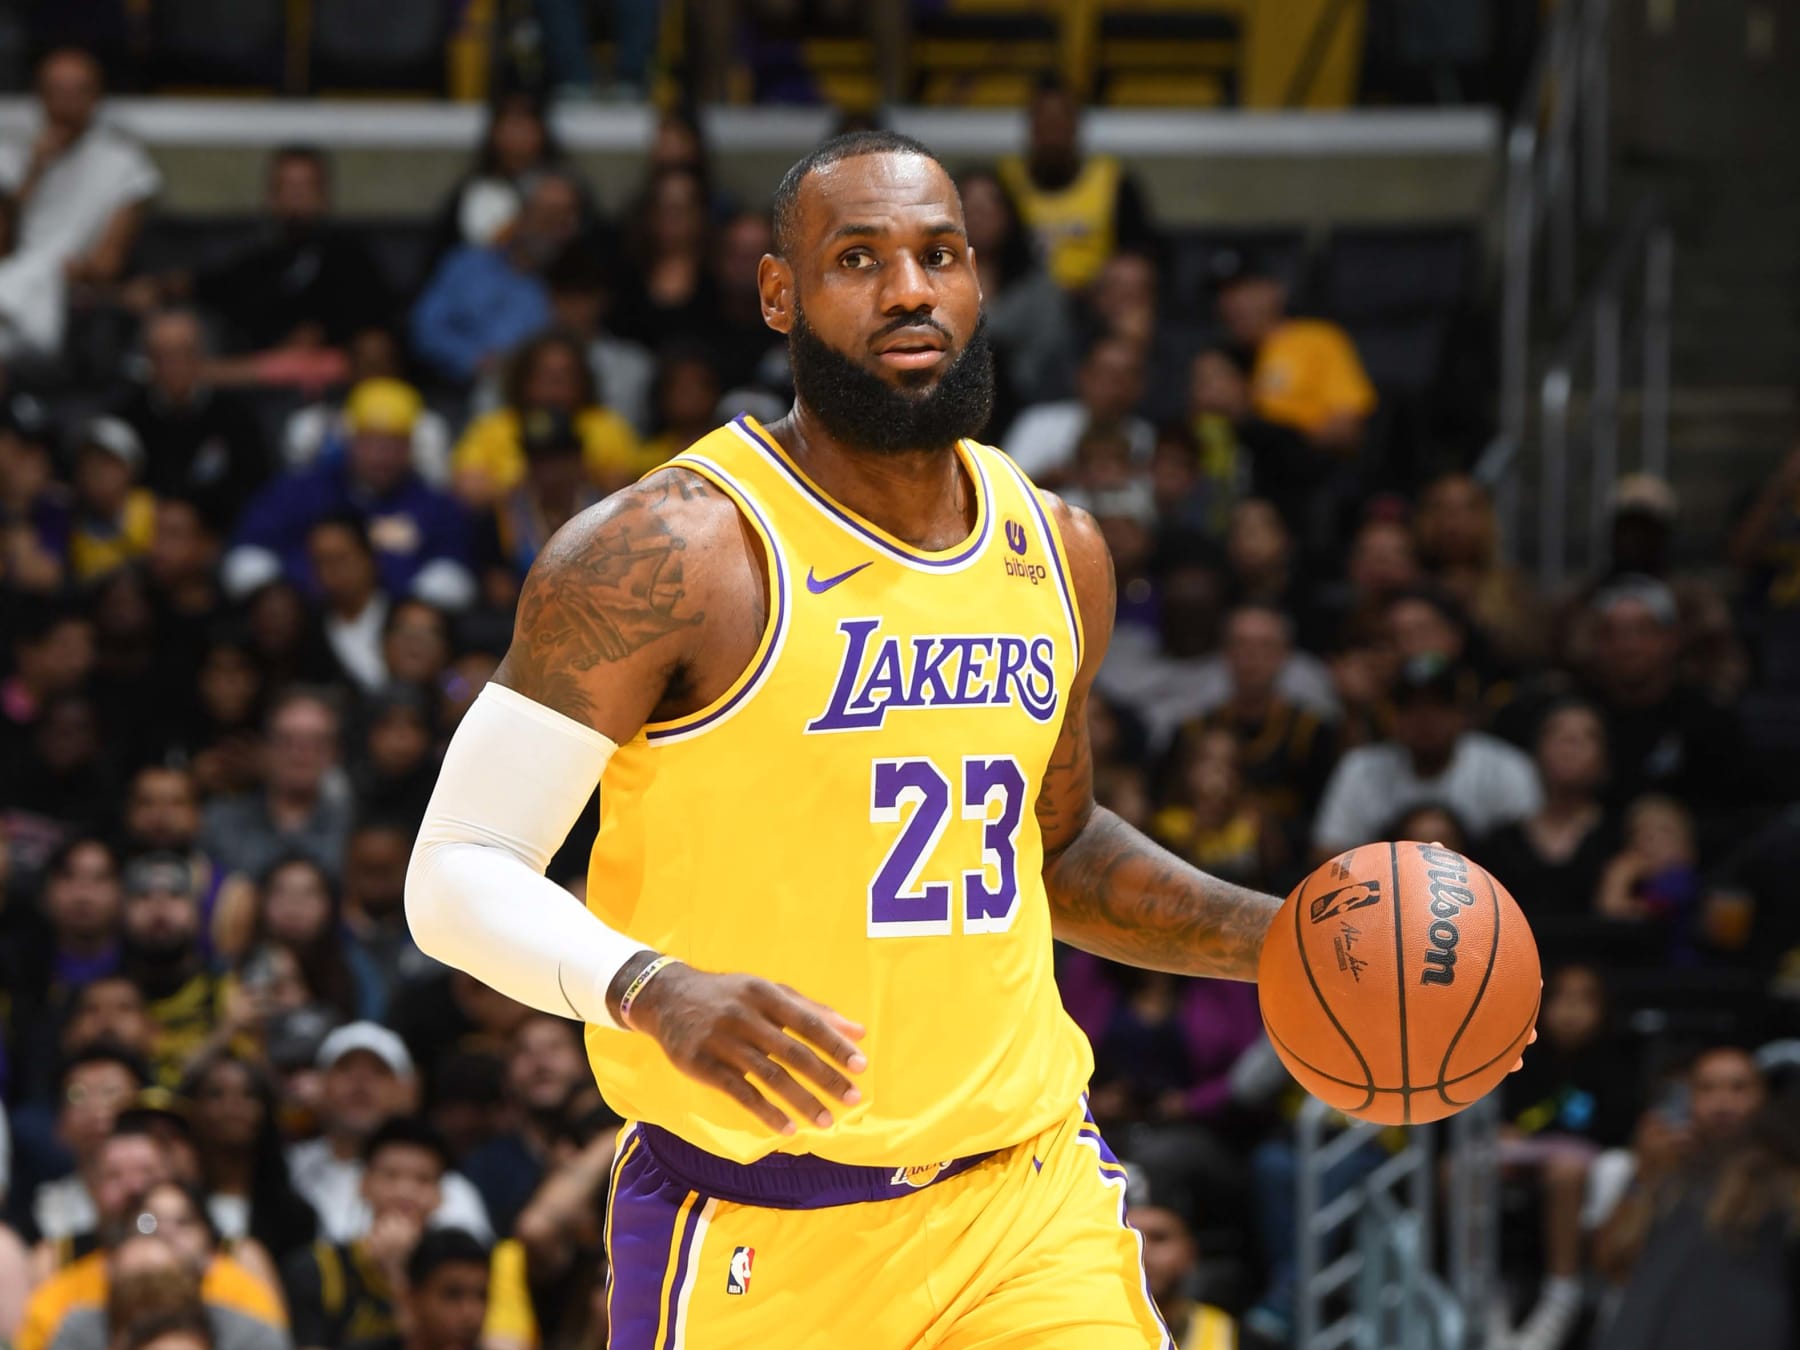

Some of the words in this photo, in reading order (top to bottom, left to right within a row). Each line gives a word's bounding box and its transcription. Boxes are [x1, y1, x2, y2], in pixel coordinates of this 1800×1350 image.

[1004, 556, 1046, 585] bibigo
[804, 617, 1058, 734] LAKERS
[867, 755, 1028, 938] 23
